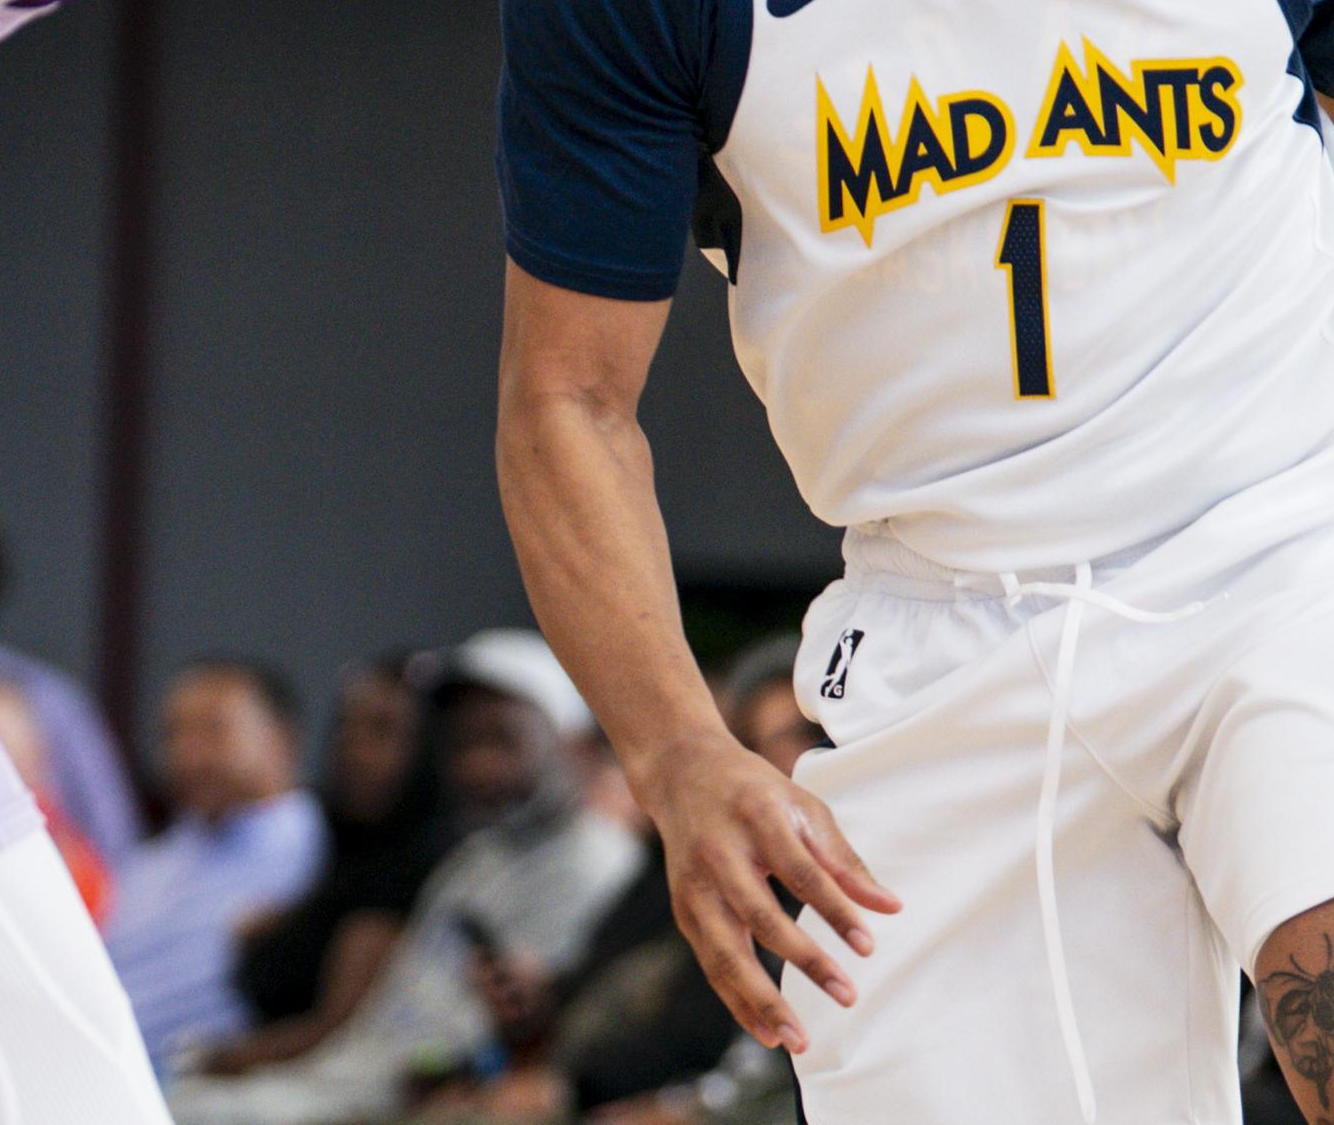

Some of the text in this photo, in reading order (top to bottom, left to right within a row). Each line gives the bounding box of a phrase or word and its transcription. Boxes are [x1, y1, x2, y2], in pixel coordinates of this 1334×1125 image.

[815, 34, 1244, 248] MAD ANTS
[994, 198, 1056, 400] 1
